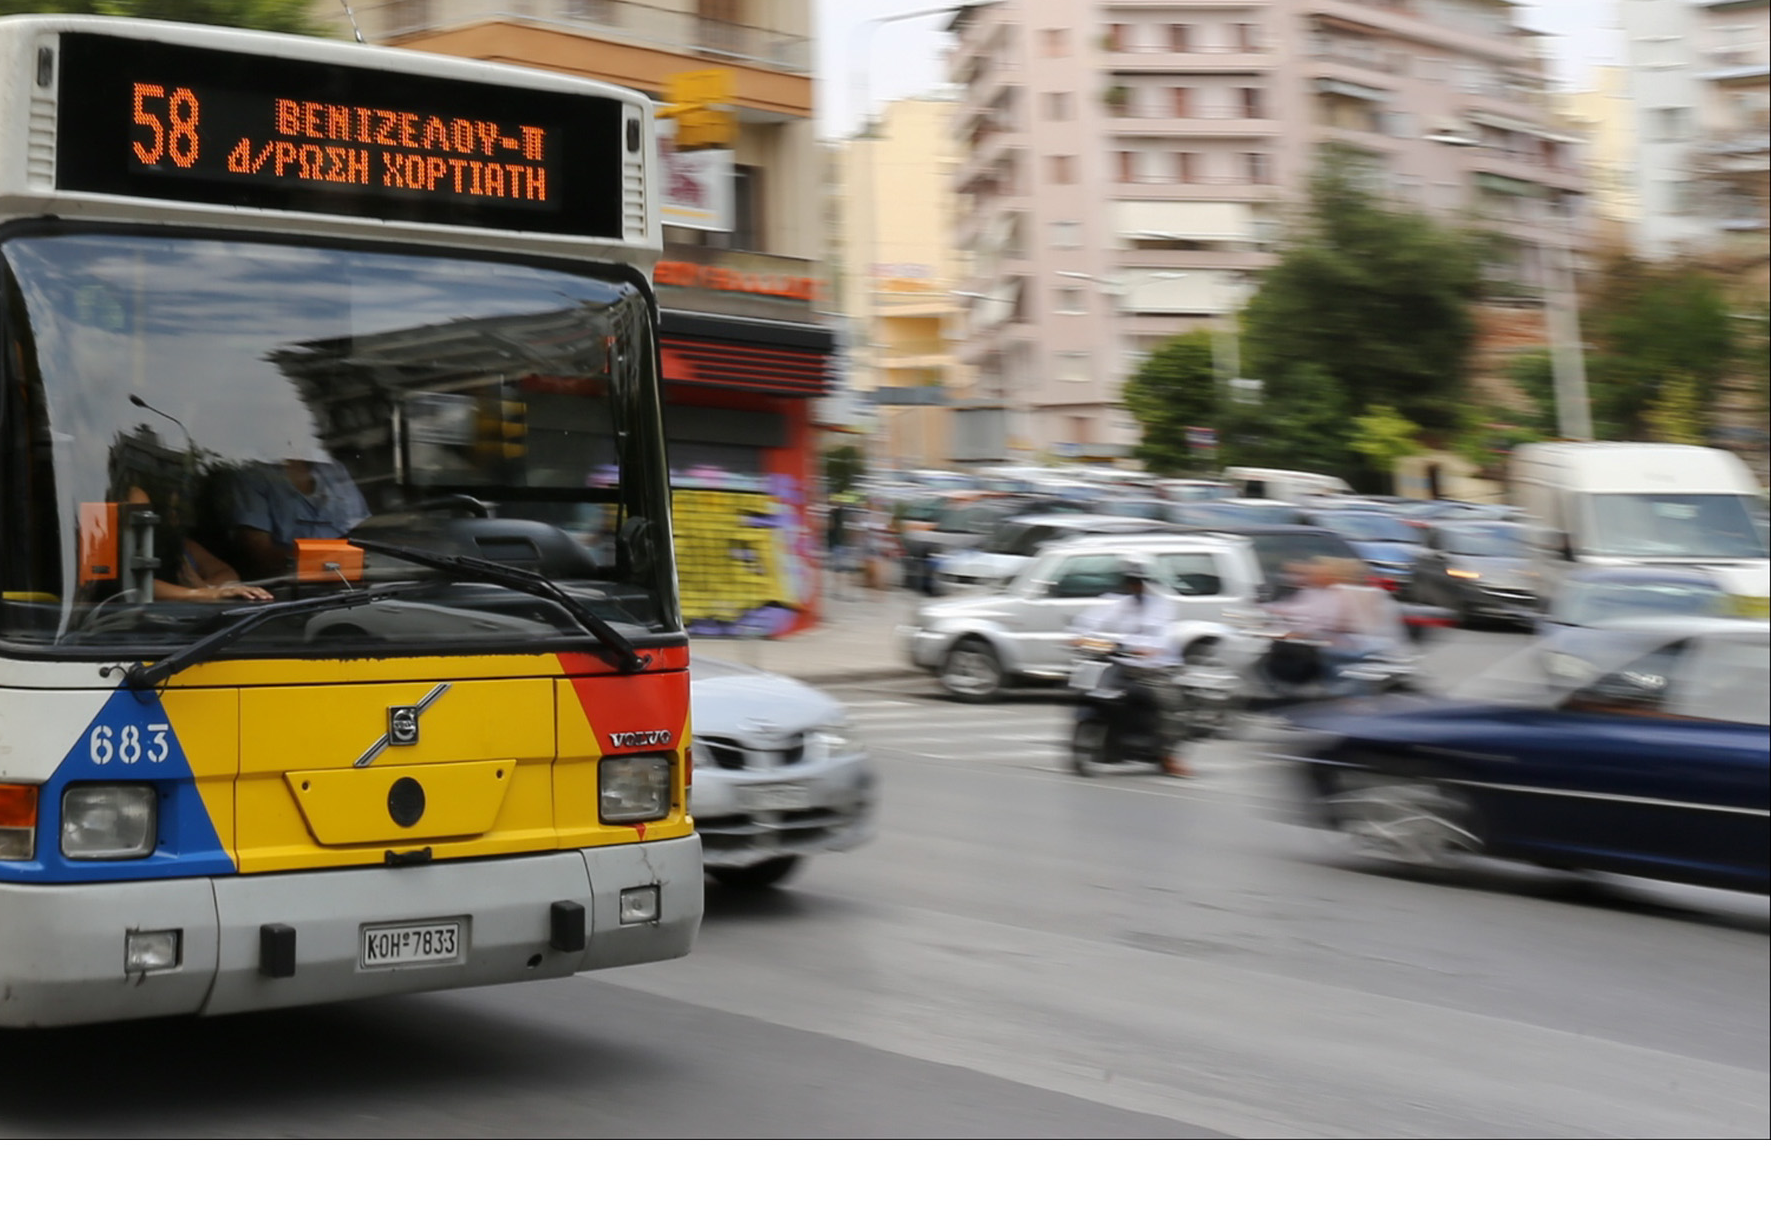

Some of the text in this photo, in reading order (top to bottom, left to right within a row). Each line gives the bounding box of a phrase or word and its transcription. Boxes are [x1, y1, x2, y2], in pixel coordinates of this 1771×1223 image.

[132, 82, 201, 169] 58
[381, 151, 546, 201] ΧΟΡΤΙΑΤΗ
[90, 724, 169, 765] 683
[609, 730, 671, 747] VOLVO
